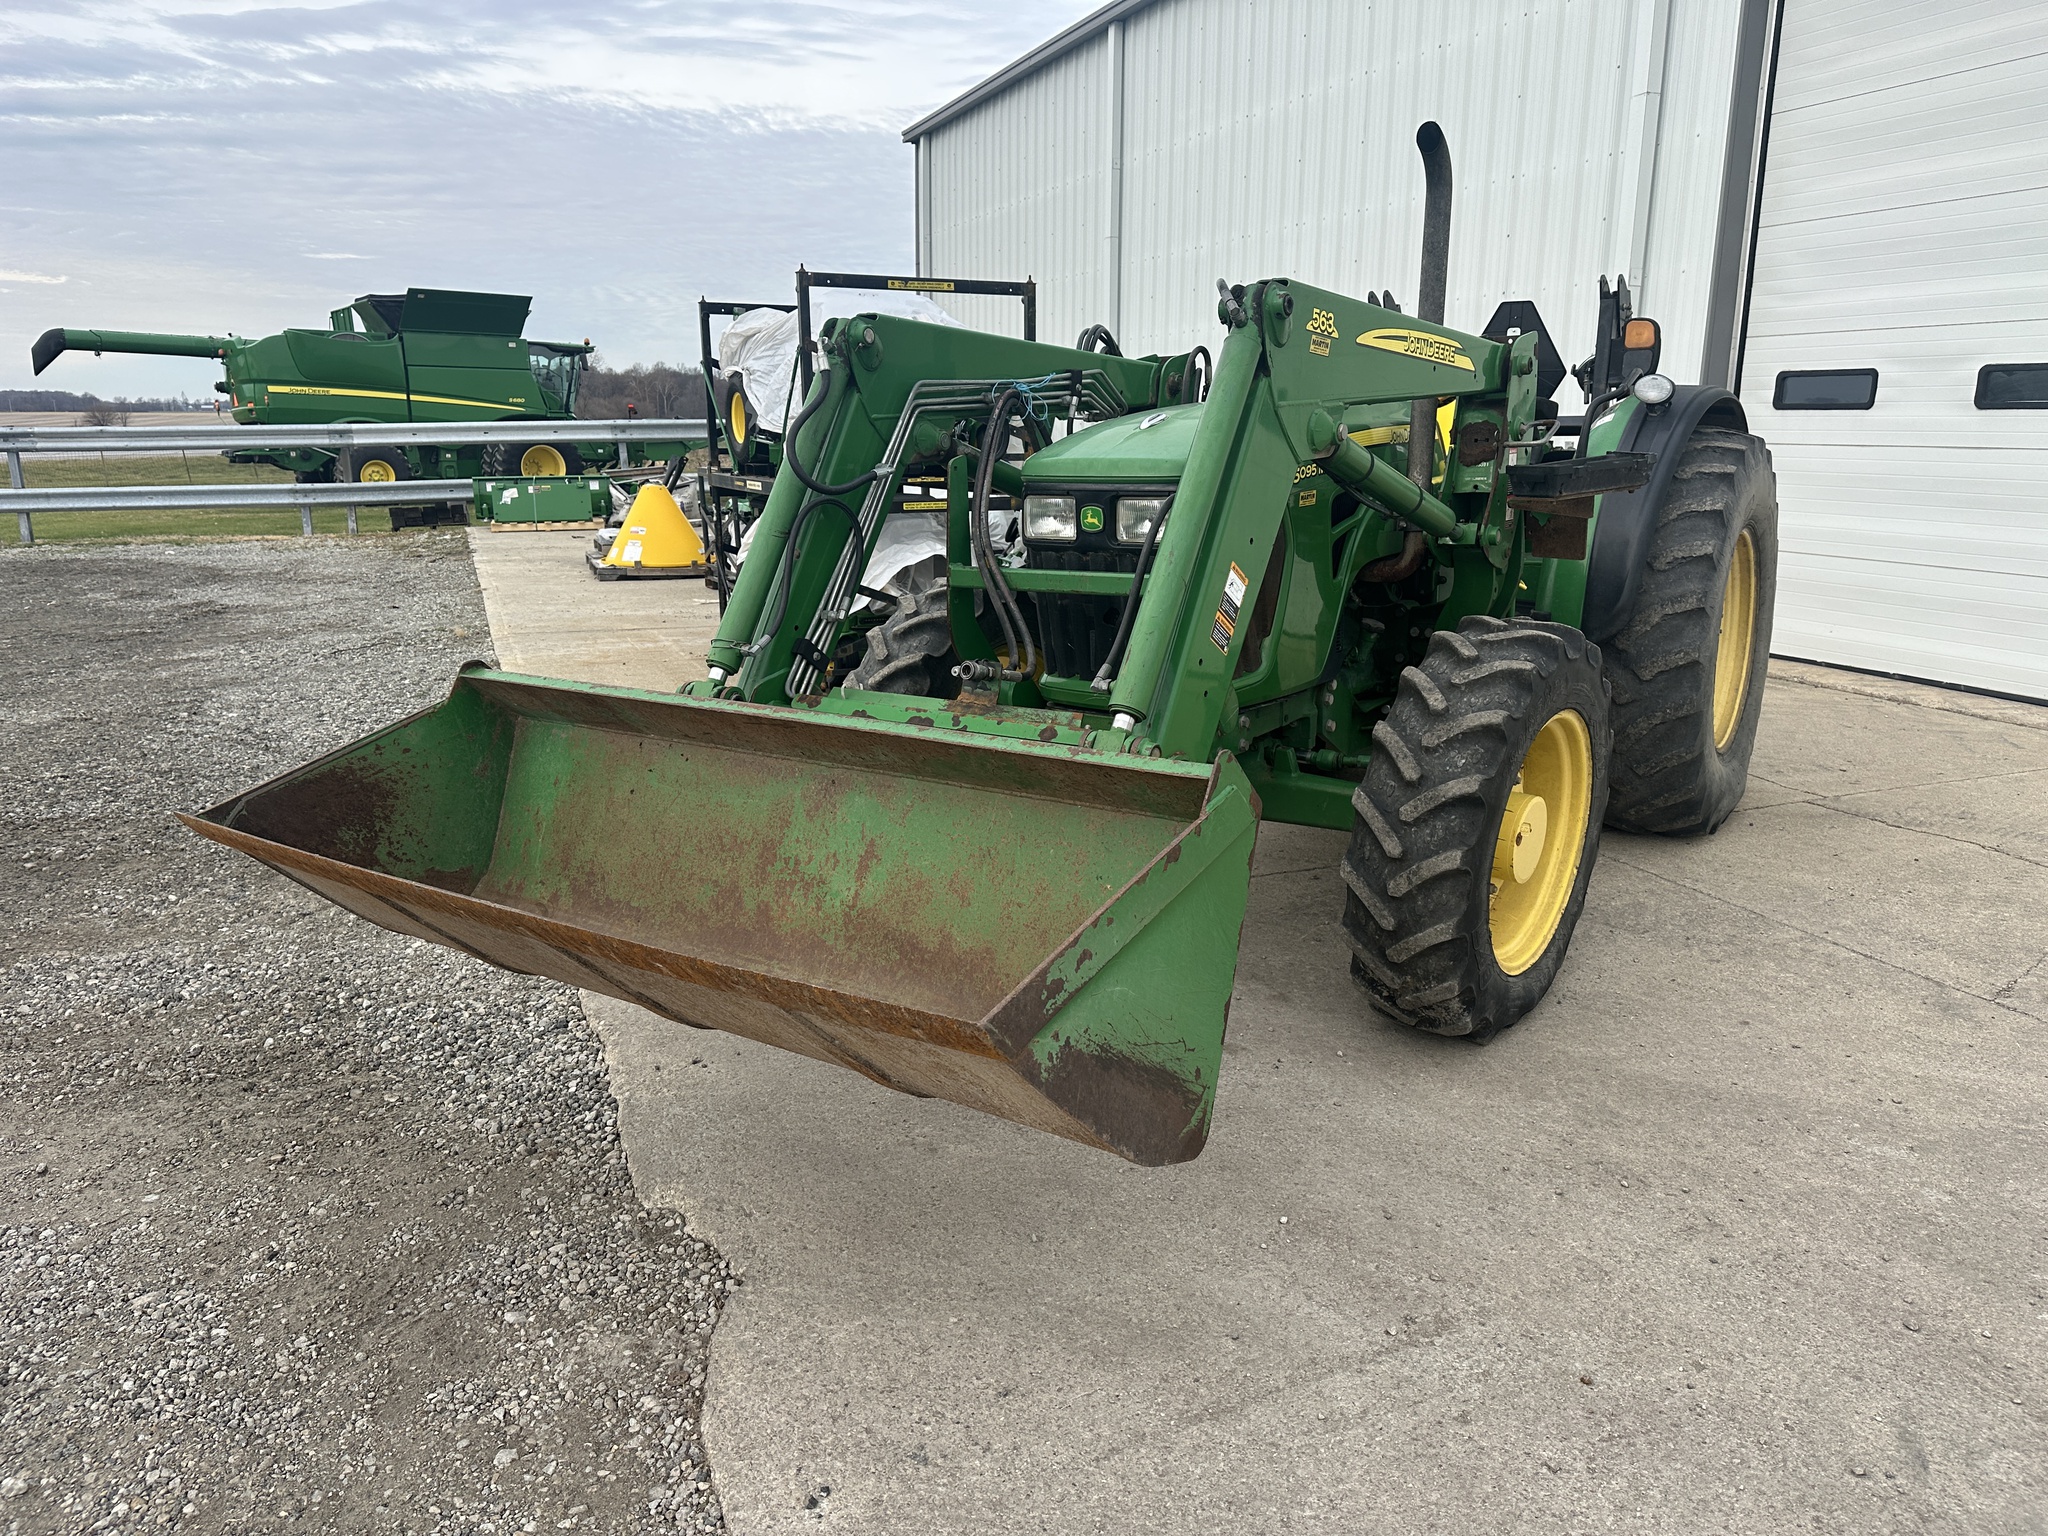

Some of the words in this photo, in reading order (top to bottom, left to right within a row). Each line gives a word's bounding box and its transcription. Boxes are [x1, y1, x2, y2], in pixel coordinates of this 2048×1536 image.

[1312, 307, 1335, 334] 563
[1312, 338, 1329, 350] MARTIN
[1403, 332, 1428, 357] JOHN
[1428, 337, 1456, 363] DEERE
[288, 387, 307, 395] JOHN
[307, 387, 331, 395] DEERE
